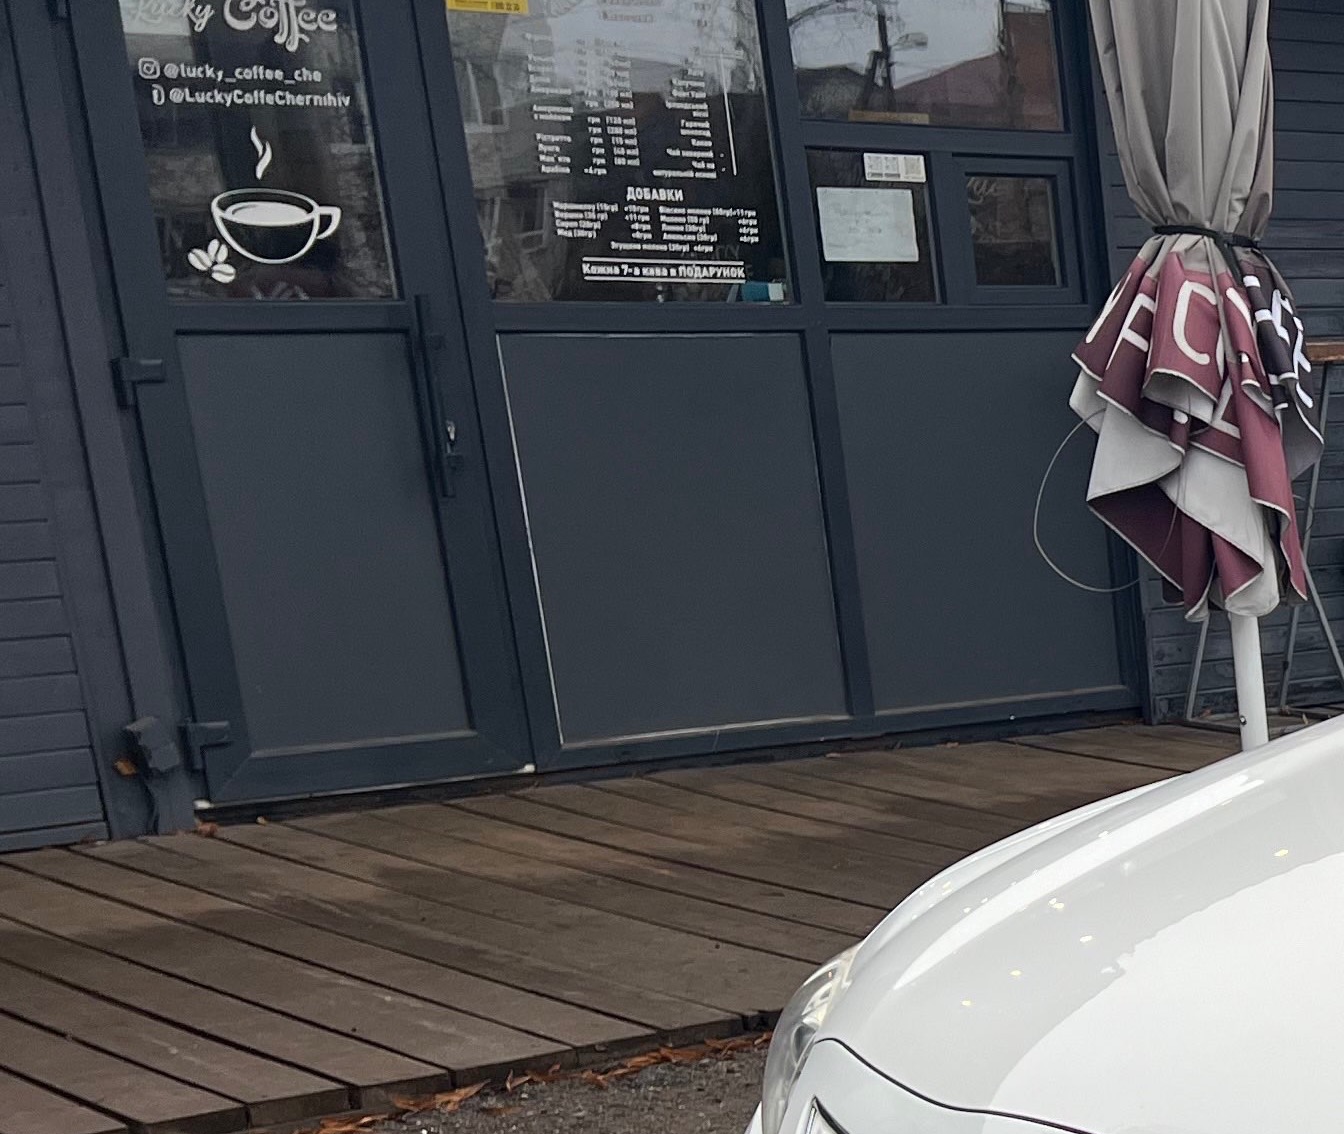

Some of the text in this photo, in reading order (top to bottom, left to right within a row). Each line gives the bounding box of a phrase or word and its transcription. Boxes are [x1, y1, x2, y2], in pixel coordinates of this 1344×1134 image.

[224, 0, 337, 52] Coffee
[626, 186, 684, 202] ДОБАВКИ
[678, 263, 746, 279] ПОДАРУНОК
